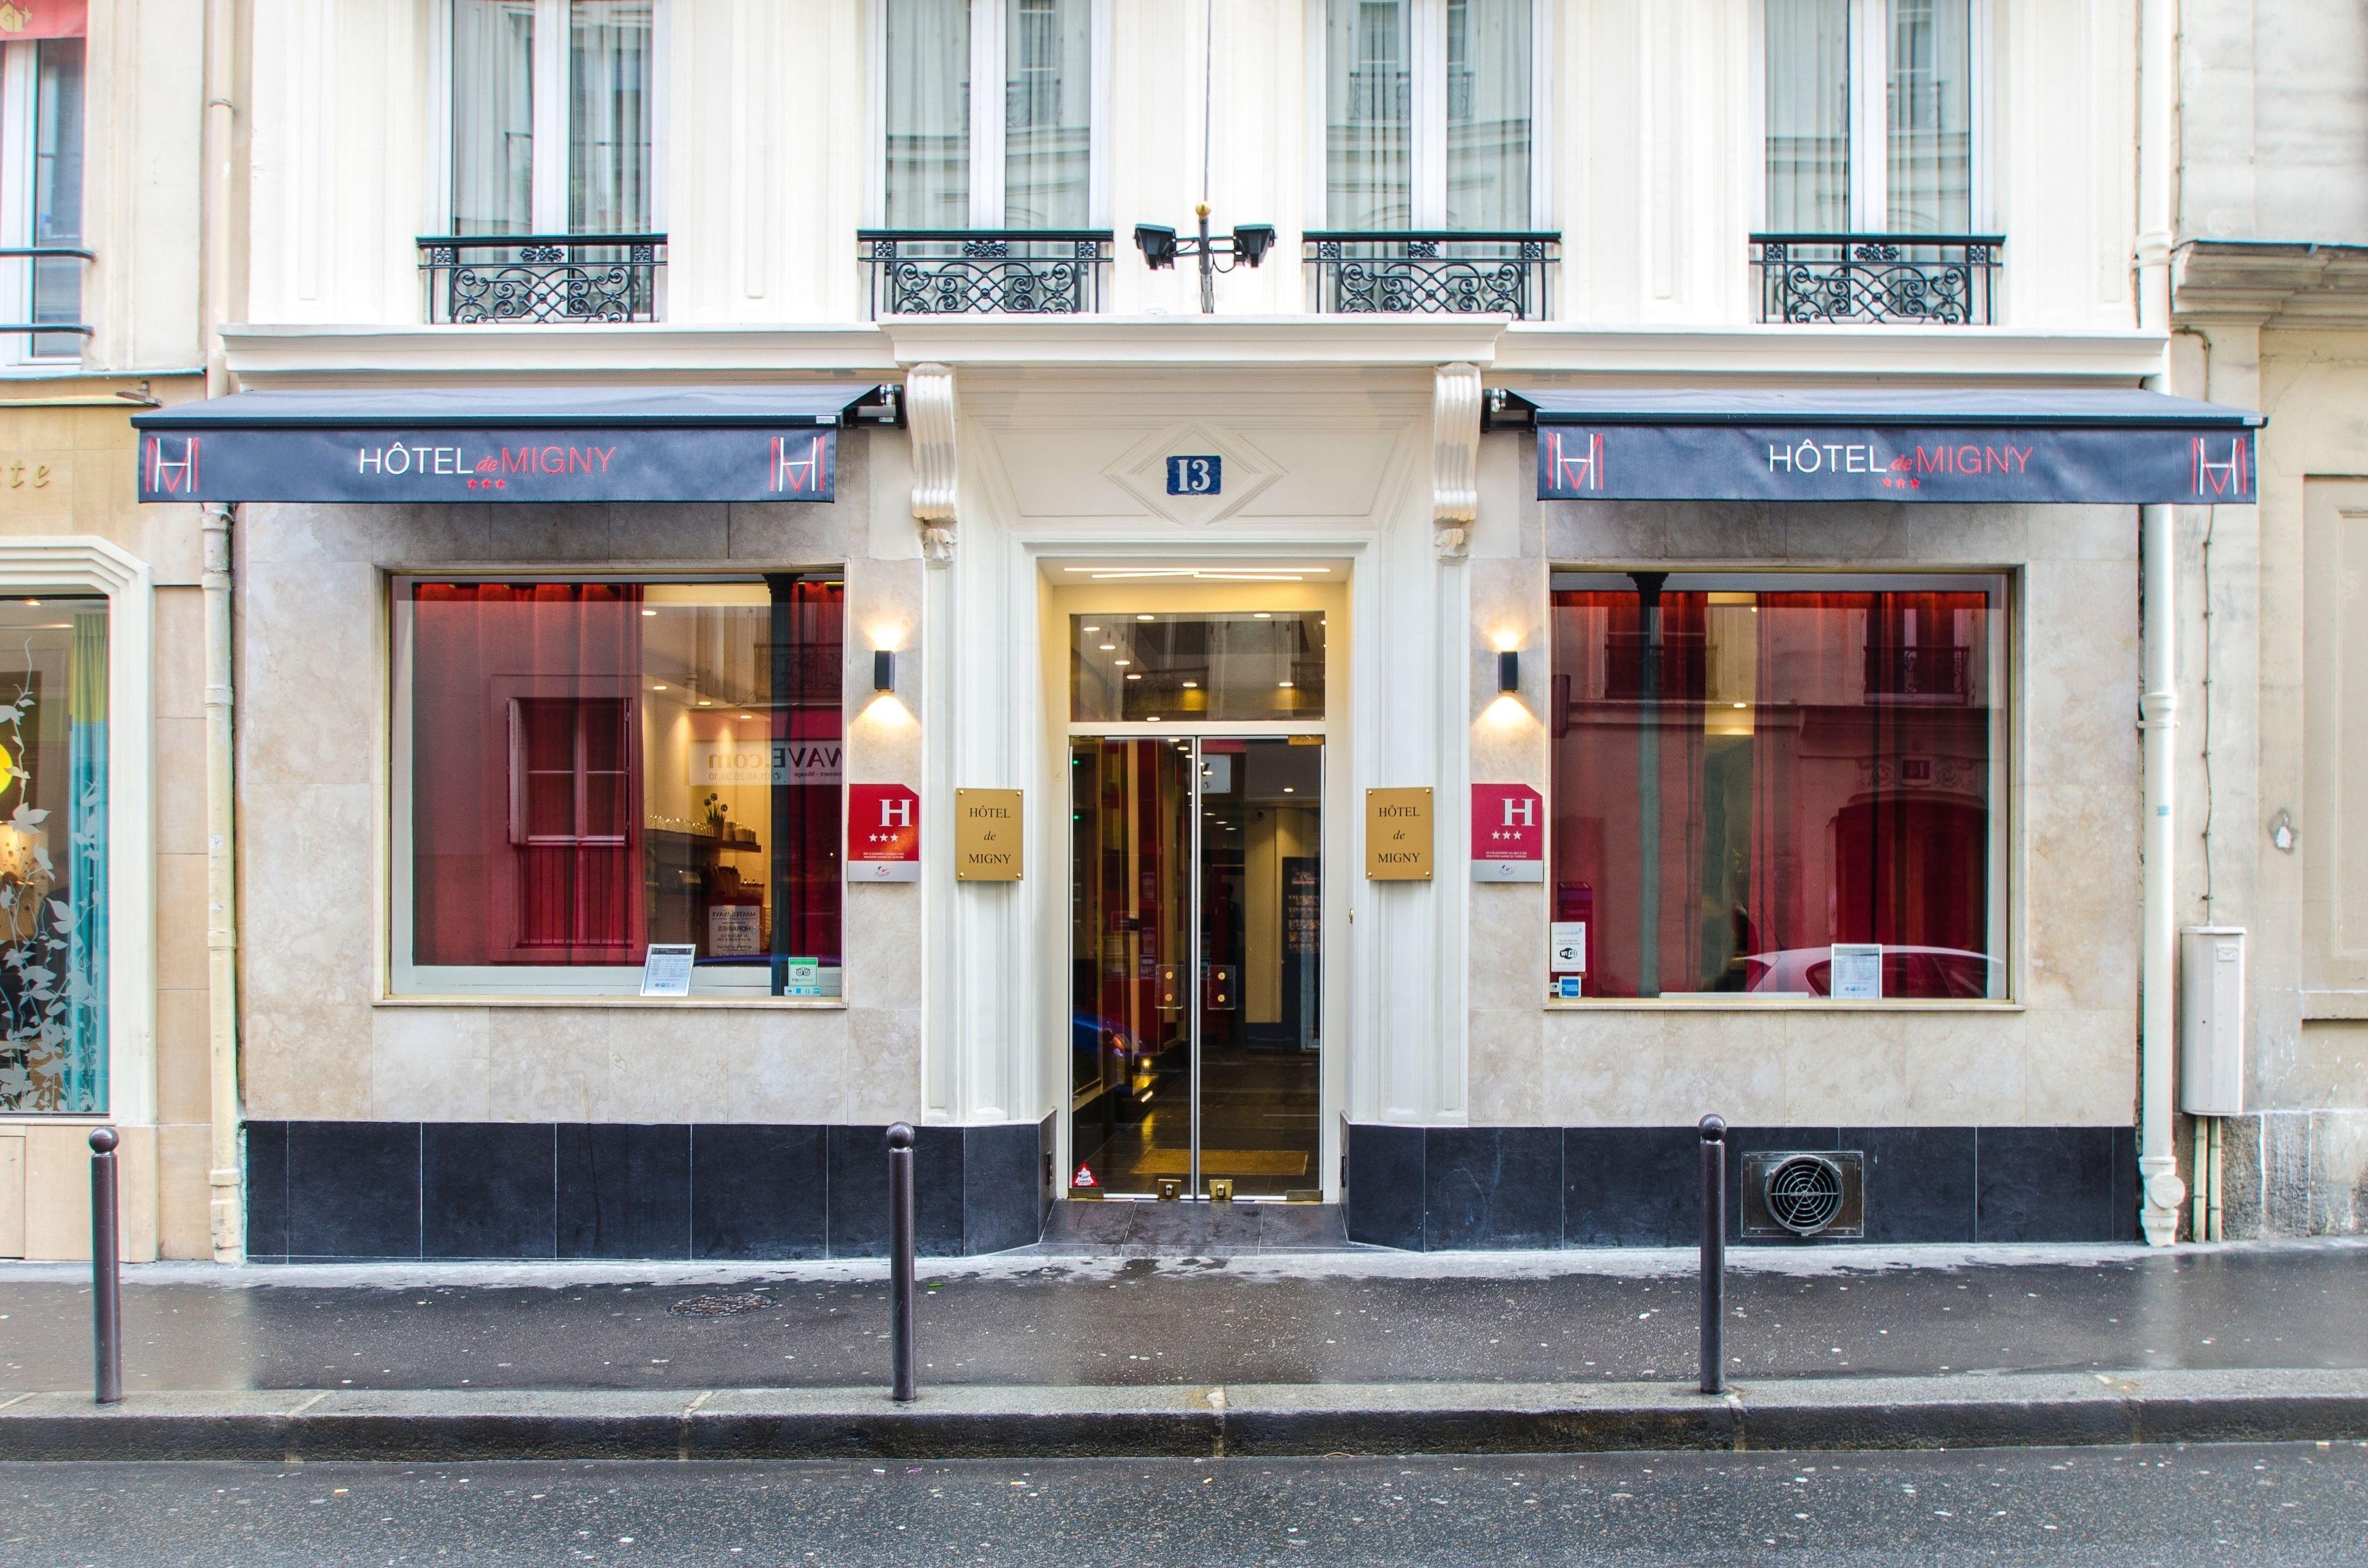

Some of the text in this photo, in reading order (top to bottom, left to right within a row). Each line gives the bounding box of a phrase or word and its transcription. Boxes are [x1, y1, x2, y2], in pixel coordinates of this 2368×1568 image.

[360, 441, 616, 475] HÔTEL de MIGNY
[1769, 438, 2034, 474] HÔTEL de MIGNY
[1177, 459, 1211, 491] 13
[878, 798, 913, 827] H
[969, 805, 1011, 818] HÔTEL
[1379, 804, 1420, 818] HÔTEL
[1500, 798, 1536, 827] H
[984, 831, 997, 841] de
[1392, 829, 1405, 840] de
[969, 853, 1011, 864] MIGNY
[1378, 852, 1420, 863] MIGNY
